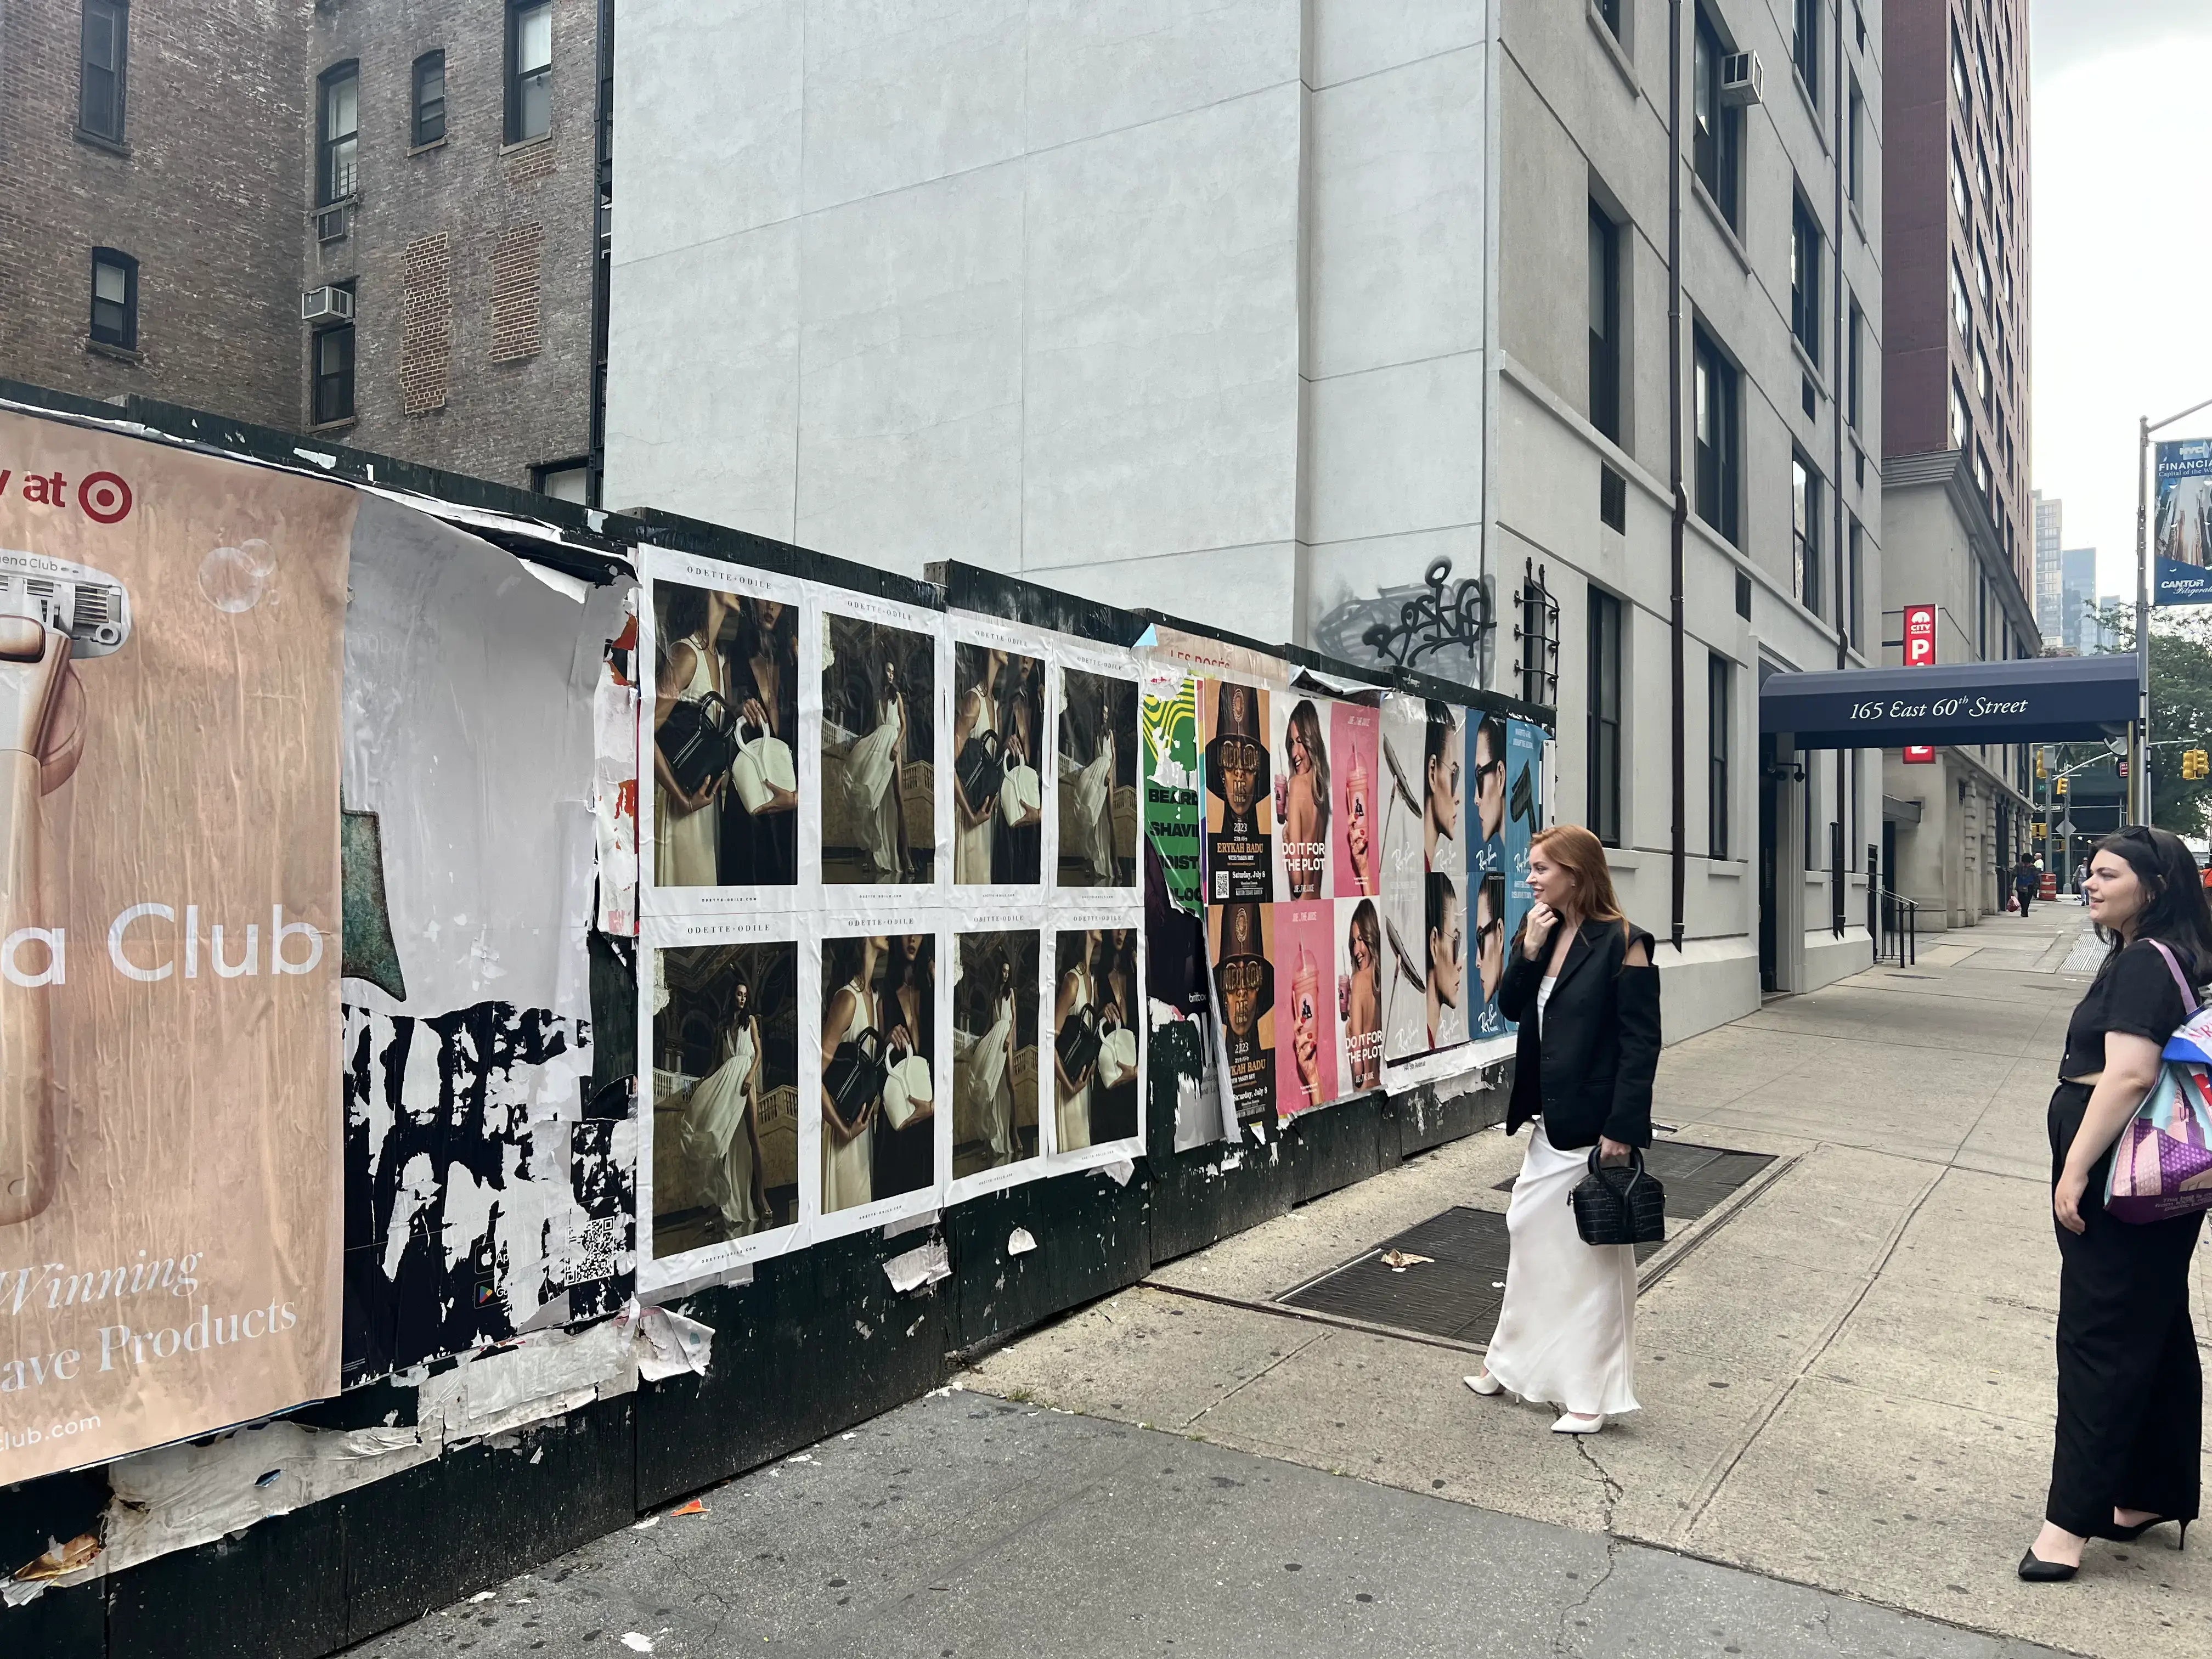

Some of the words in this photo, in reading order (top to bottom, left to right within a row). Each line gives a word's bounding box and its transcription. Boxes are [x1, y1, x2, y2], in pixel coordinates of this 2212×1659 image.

[23, 472, 67, 508] at
[29, 557, 58, 571] Club
[2161, 579, 2204, 589] CANTOR
[1849, 701, 1884, 719] 165
[1889, 701, 1927, 718] East
[1969, 697, 2028, 717] Street
[1217, 842, 1245, 853] ERYKAH
[1246, 843, 1263, 853] BADU
[1282, 842, 1295, 855] DO
[1297, 842, 1305, 855] IT
[1307, 842, 1325, 855] FOR
[1282, 859, 1301, 871] THE
[1302, 858, 1325, 871] PLOT
[108, 902, 324, 982] Club
[1345, 1035, 1357, 1049] DO
[1358, 1033, 1365, 1046] IT
[1367, 1030, 1383, 1045] FOR
[1346, 1049, 1361, 1064] THE
[1362, 1045, 1383, 1060] PLOT
[1248, 1059, 1266, 1072] BADU
[1254, 1088, 1263, 1097] July
[95, 1297, 297, 1373] Products
